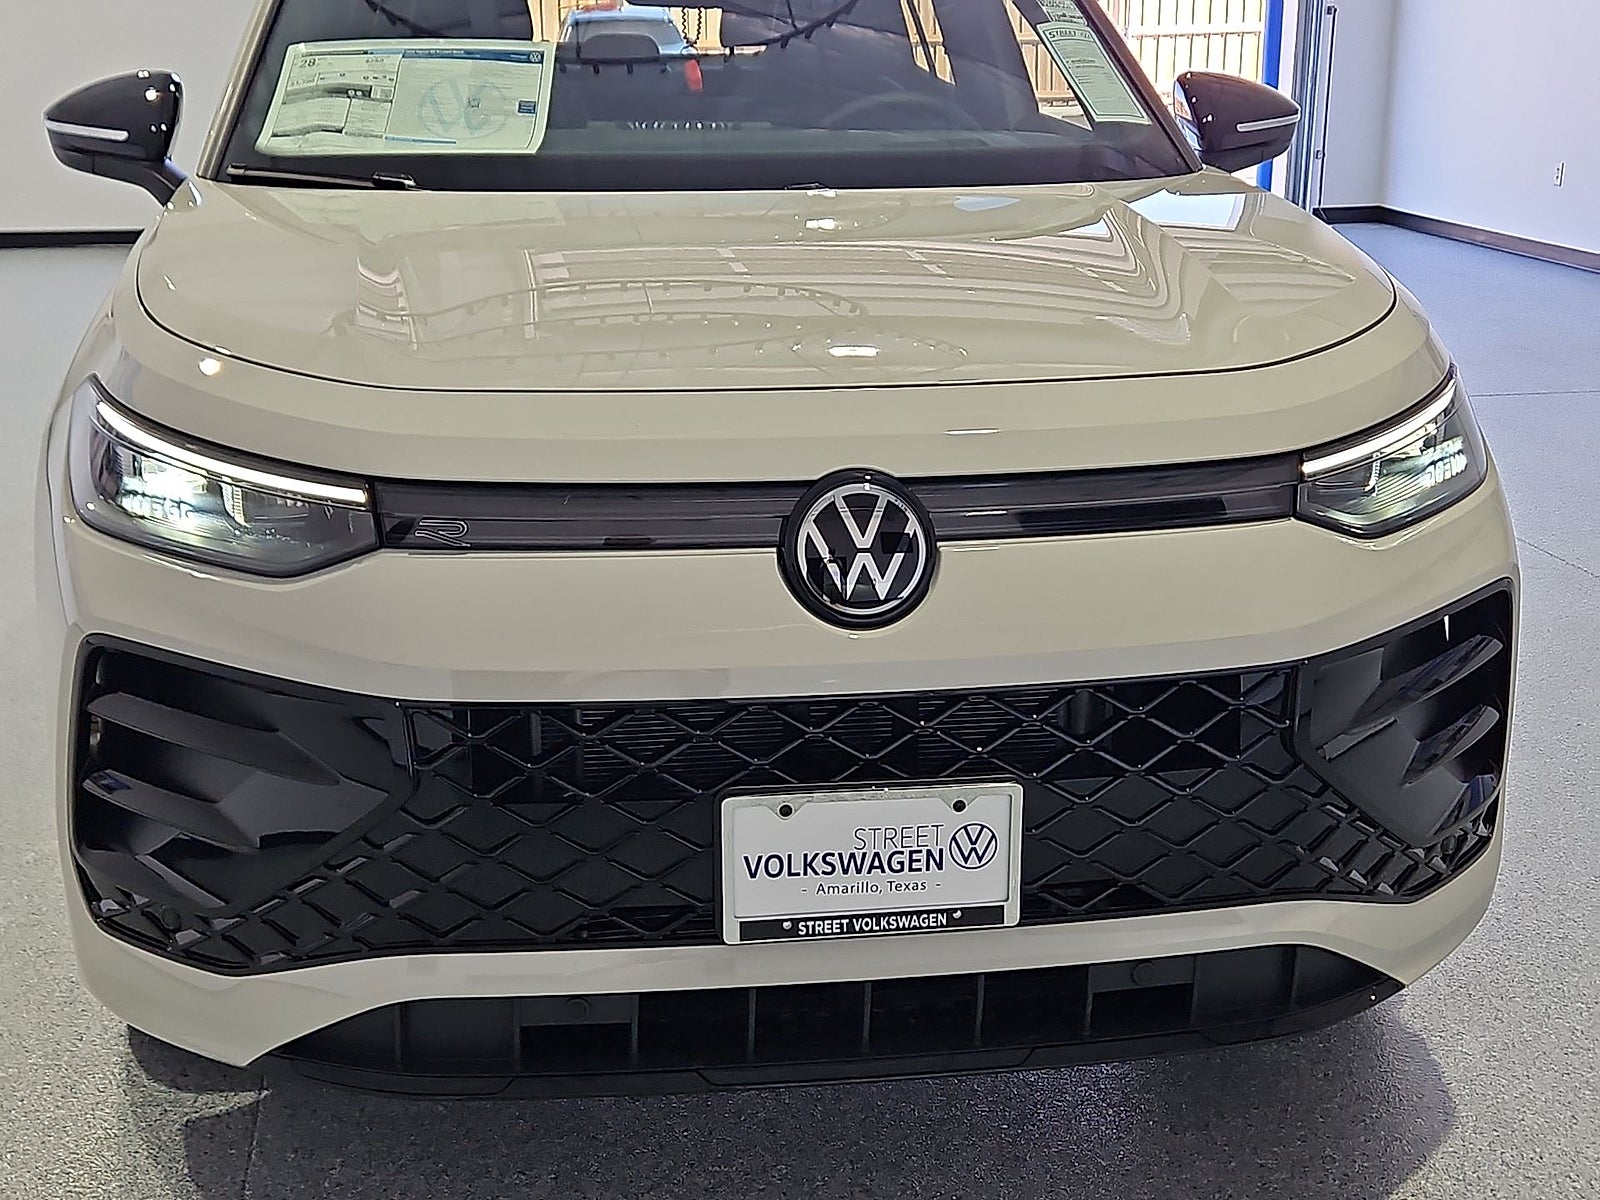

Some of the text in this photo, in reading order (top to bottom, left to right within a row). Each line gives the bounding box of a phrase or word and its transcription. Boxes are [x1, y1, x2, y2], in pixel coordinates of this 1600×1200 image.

[415, 519, 471, 547] R
[799, 487, 924, 612] VW
[853, 824, 945, 851] STREET
[949, 823, 998, 870] VW
[743, 848, 945, 879] VOLKSWAGEN
[815, 880, 883, 896] Amarillo,
[887, 878, 927, 892] Texas
[798, 912, 948, 936] STREET VOLKSWAGEN
